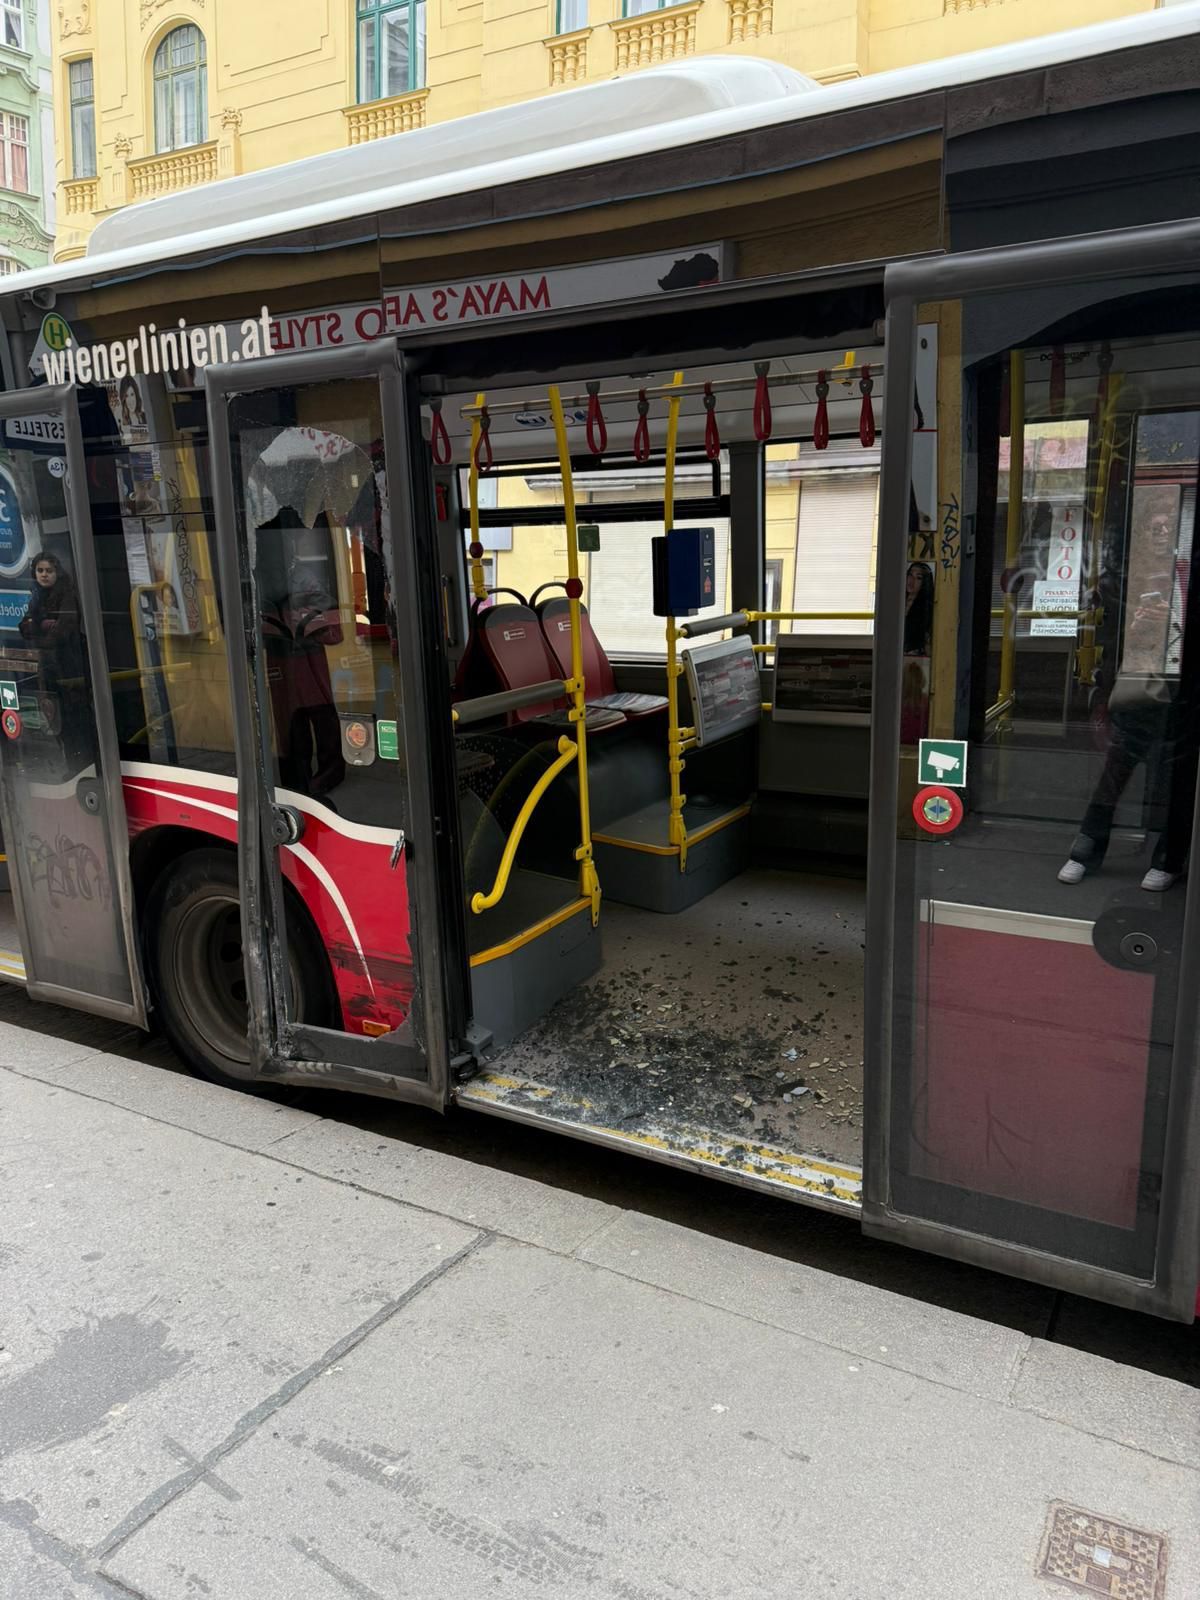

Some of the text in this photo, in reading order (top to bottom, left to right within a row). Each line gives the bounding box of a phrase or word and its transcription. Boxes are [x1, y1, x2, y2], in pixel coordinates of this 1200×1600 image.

[42, 305, 275, 386] wienerlinien.at
[49, 322, 65, 346] H
[1057, 508, 1077, 580] FOTO
[1084, 1526, 1127, 1549] GAS
